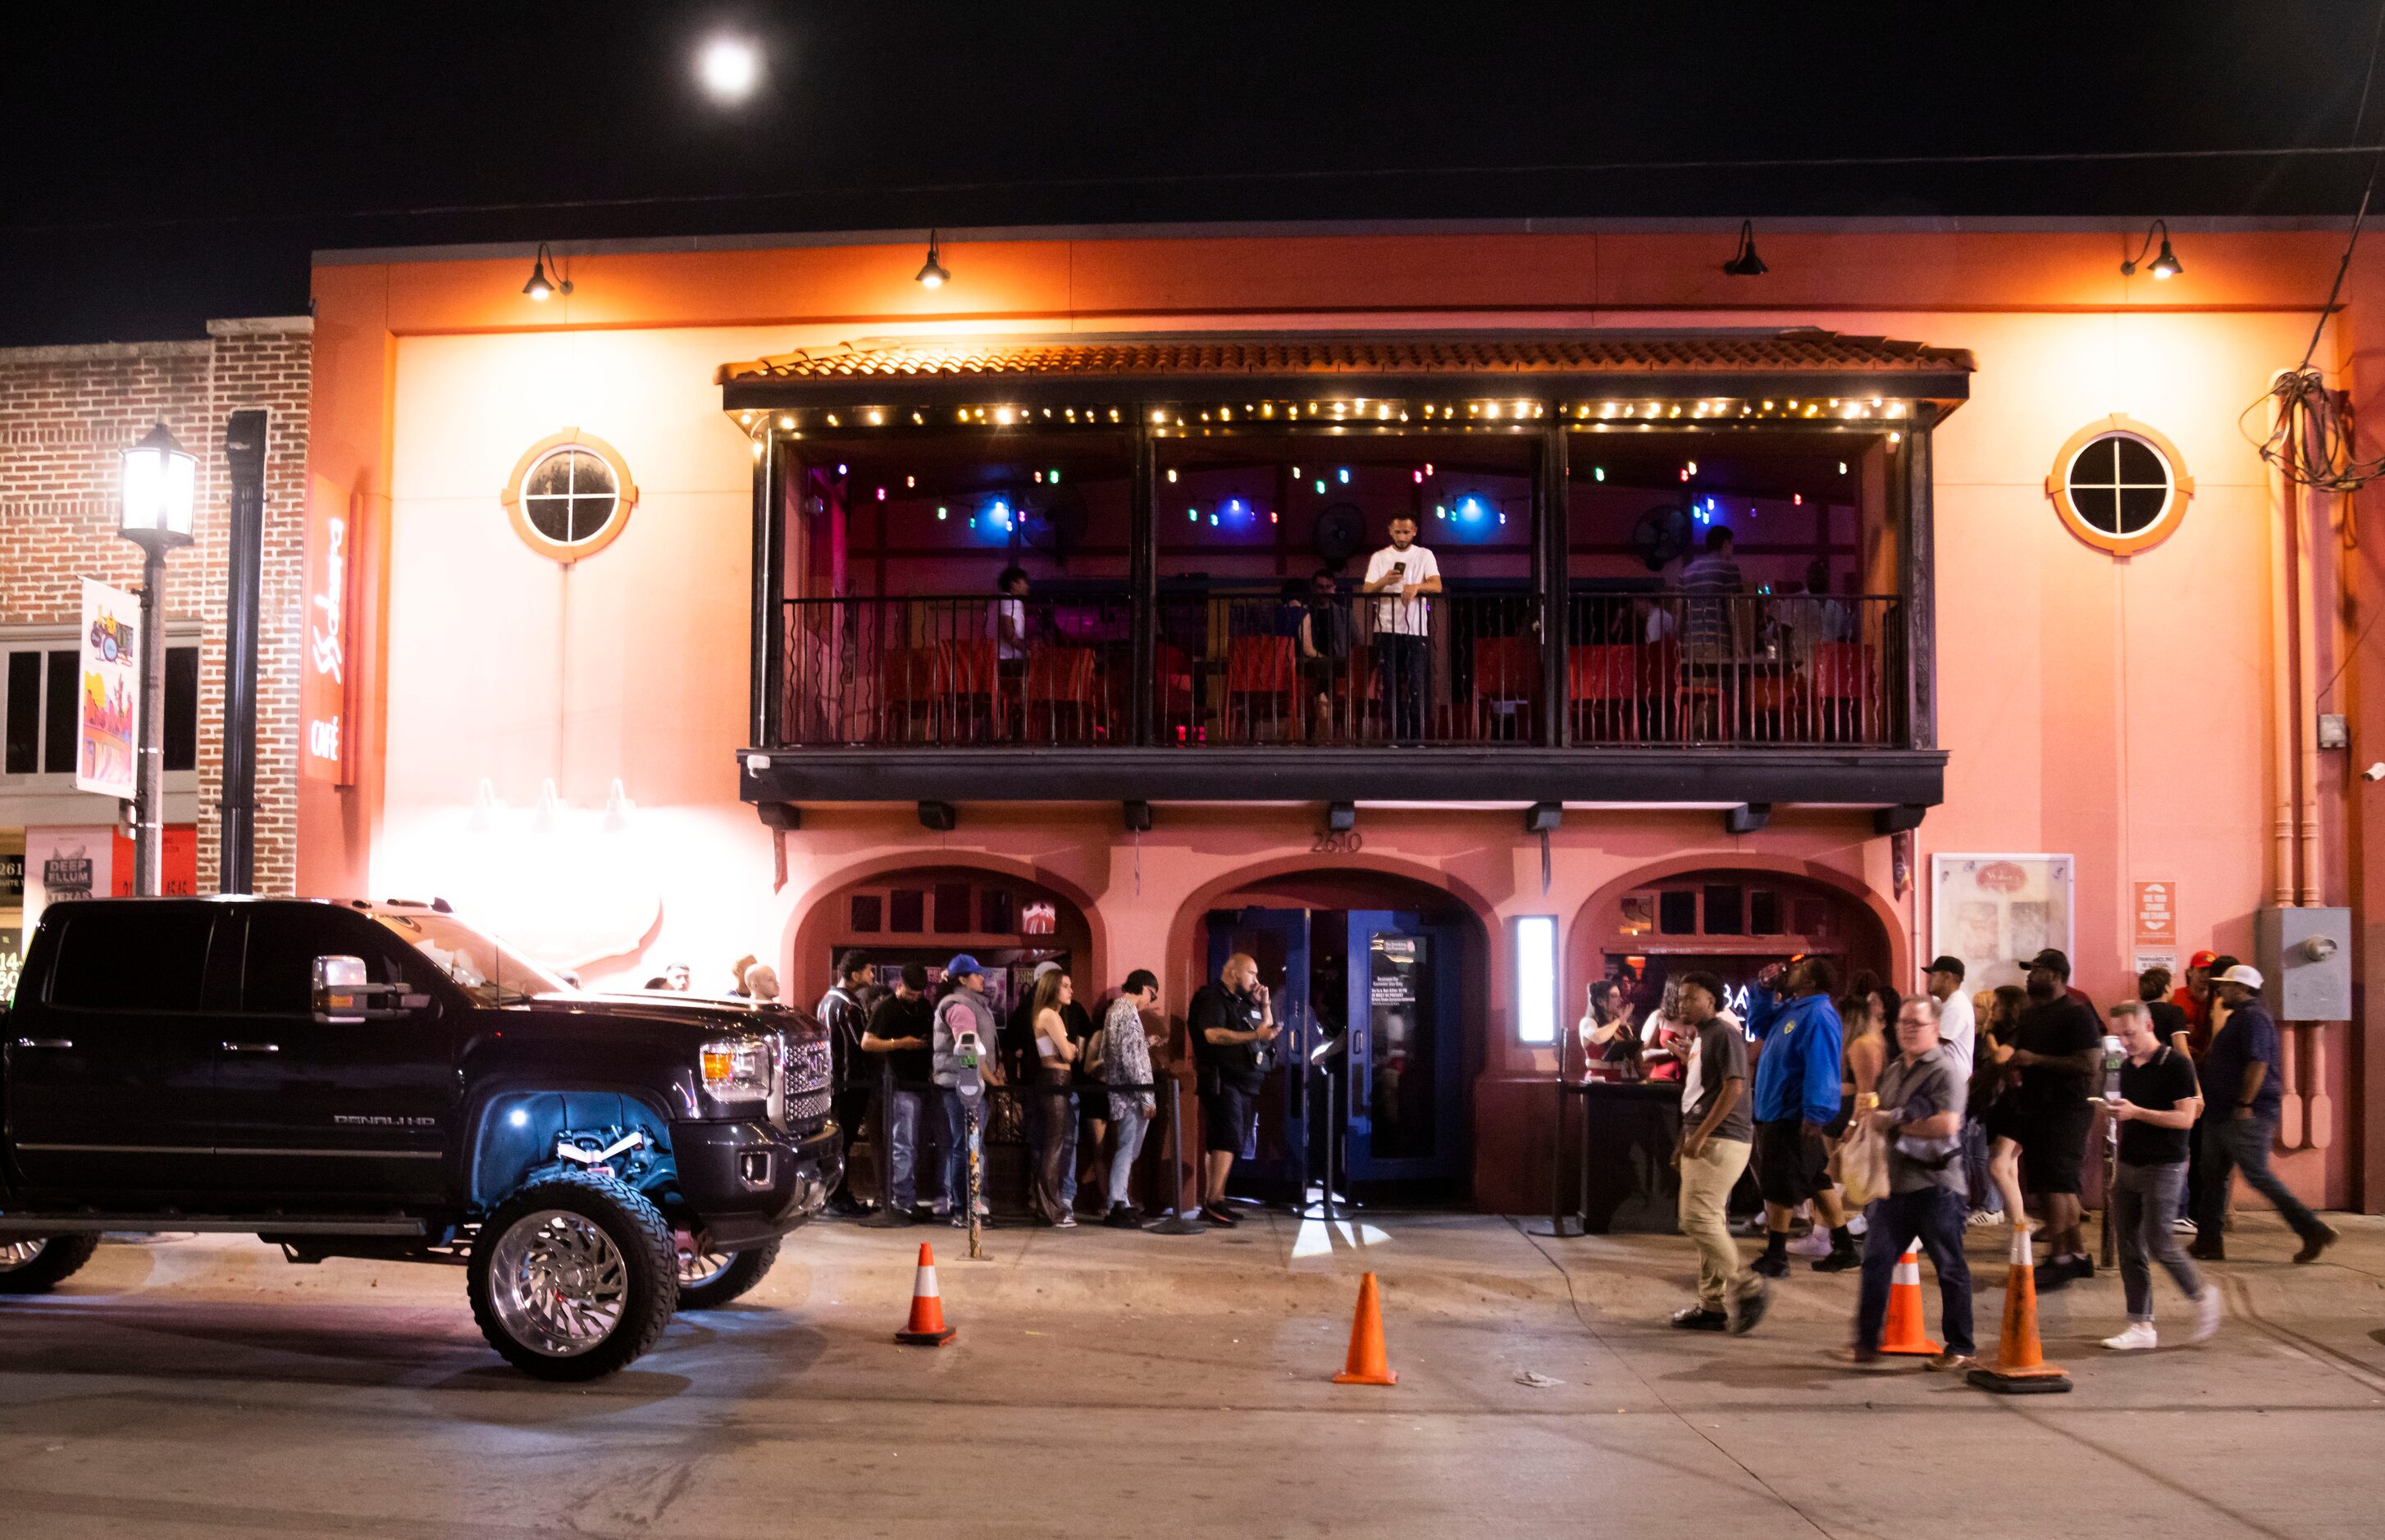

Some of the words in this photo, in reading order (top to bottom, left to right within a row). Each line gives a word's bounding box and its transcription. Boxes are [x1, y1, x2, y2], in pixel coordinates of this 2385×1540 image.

[311, 715, 339, 761] CAFÉ
[1311, 831, 1362, 853] 2610
[50, 860, 87, 872] DEEP
[48, 871, 89, 883] ELLUM
[334, 1115, 404, 1125] DENALI
[406, 1116, 435, 1125] HD
